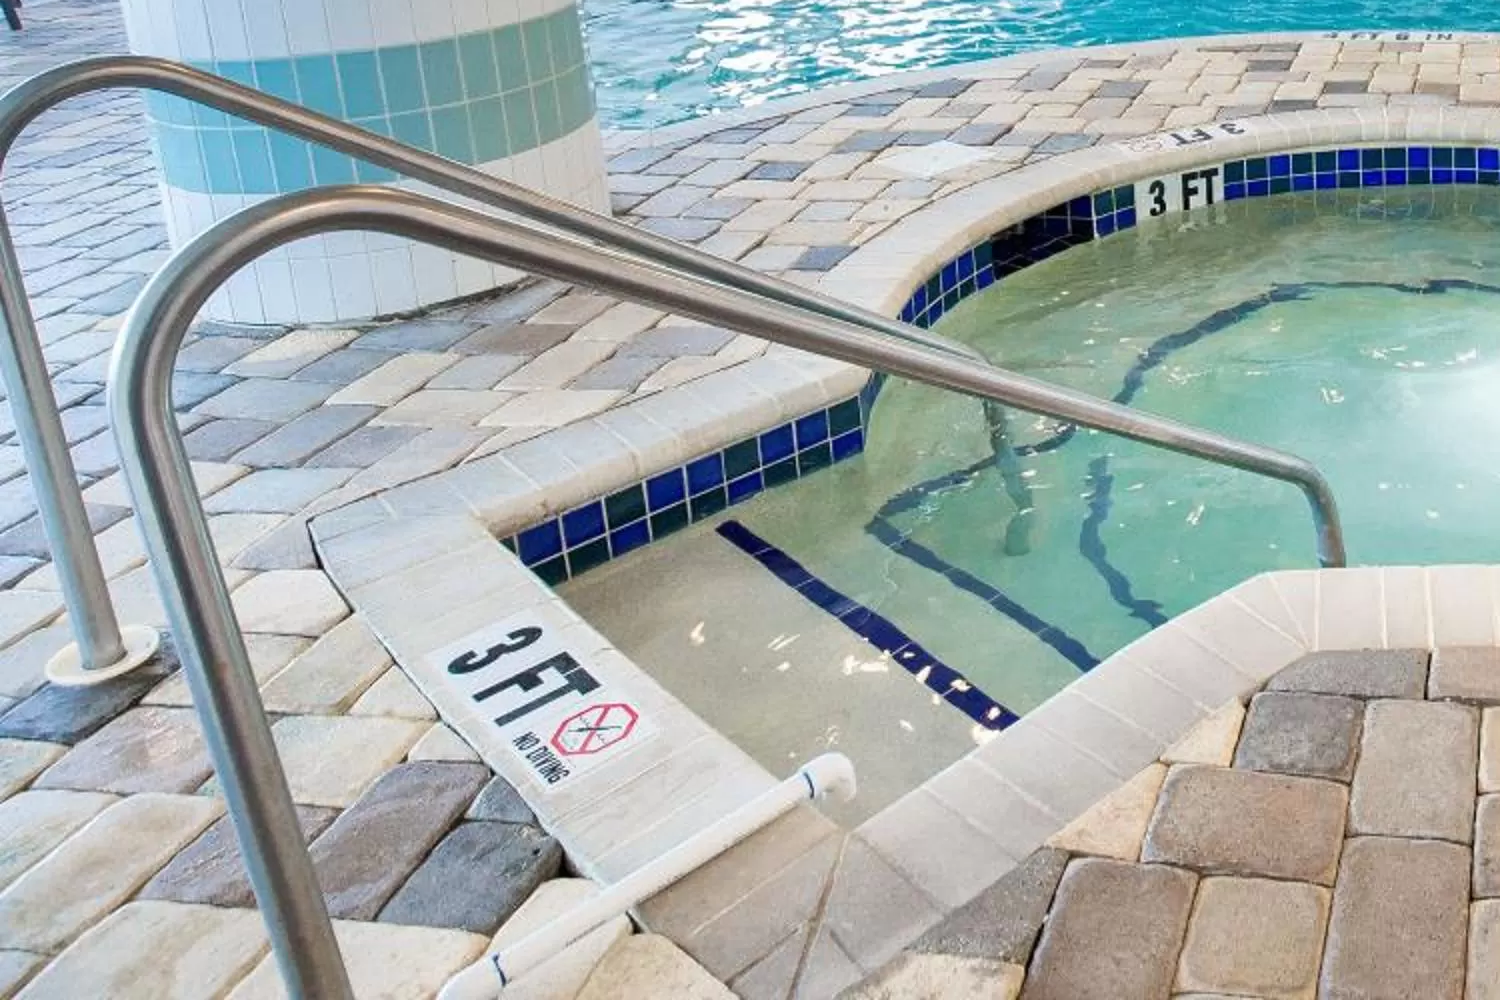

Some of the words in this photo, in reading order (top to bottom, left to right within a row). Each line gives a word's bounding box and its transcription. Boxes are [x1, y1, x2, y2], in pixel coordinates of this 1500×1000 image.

[1425, 32, 1453, 40] IN
[1167, 127, 1213, 146] FT
[1220, 122, 1245, 135] 3
[1149, 179, 1167, 217] 3
[1181, 167, 1219, 212] FT
[447, 625, 543, 675] 3
[472, 651, 602, 727] FT
[512, 732, 540, 752] NO
[528, 745, 570, 785] DIVING
